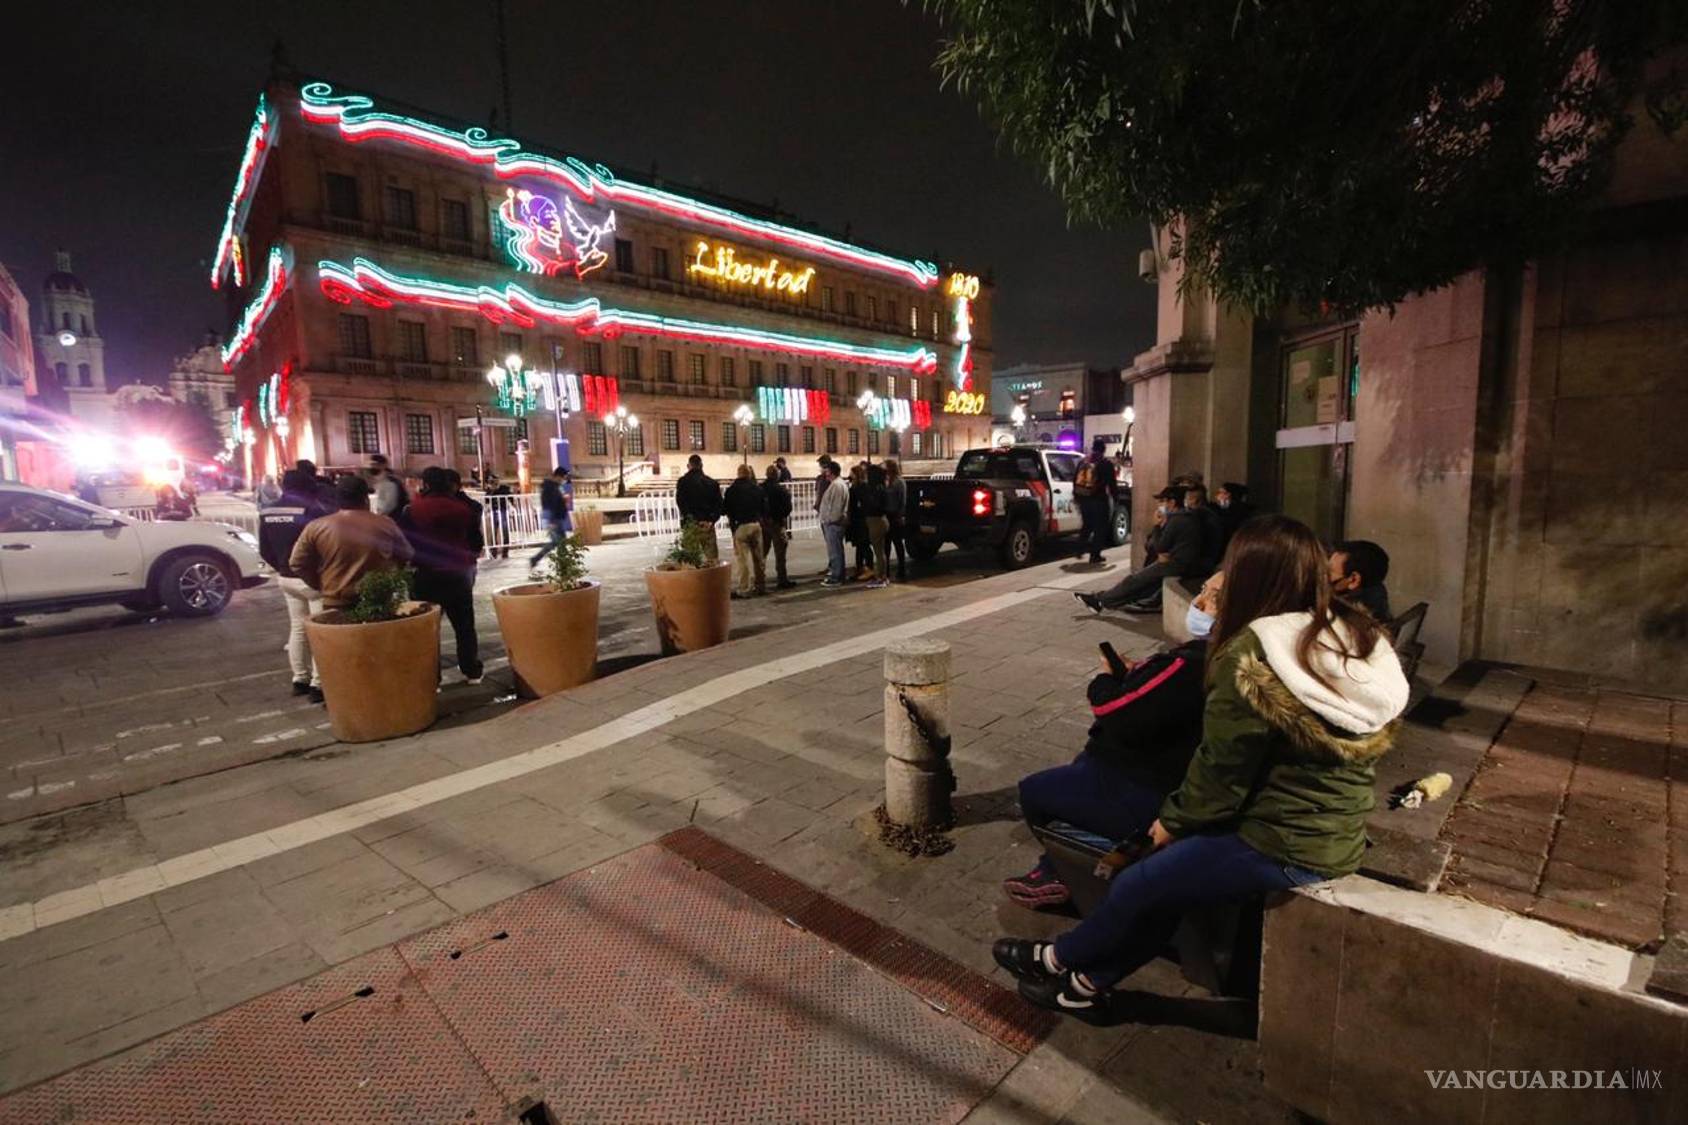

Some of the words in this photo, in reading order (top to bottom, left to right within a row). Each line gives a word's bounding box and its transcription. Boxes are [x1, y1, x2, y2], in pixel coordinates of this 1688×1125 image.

[690, 241, 816, 293] Libertad
[950, 272, 979, 299] 1810
[943, 390, 985, 415] 2020
